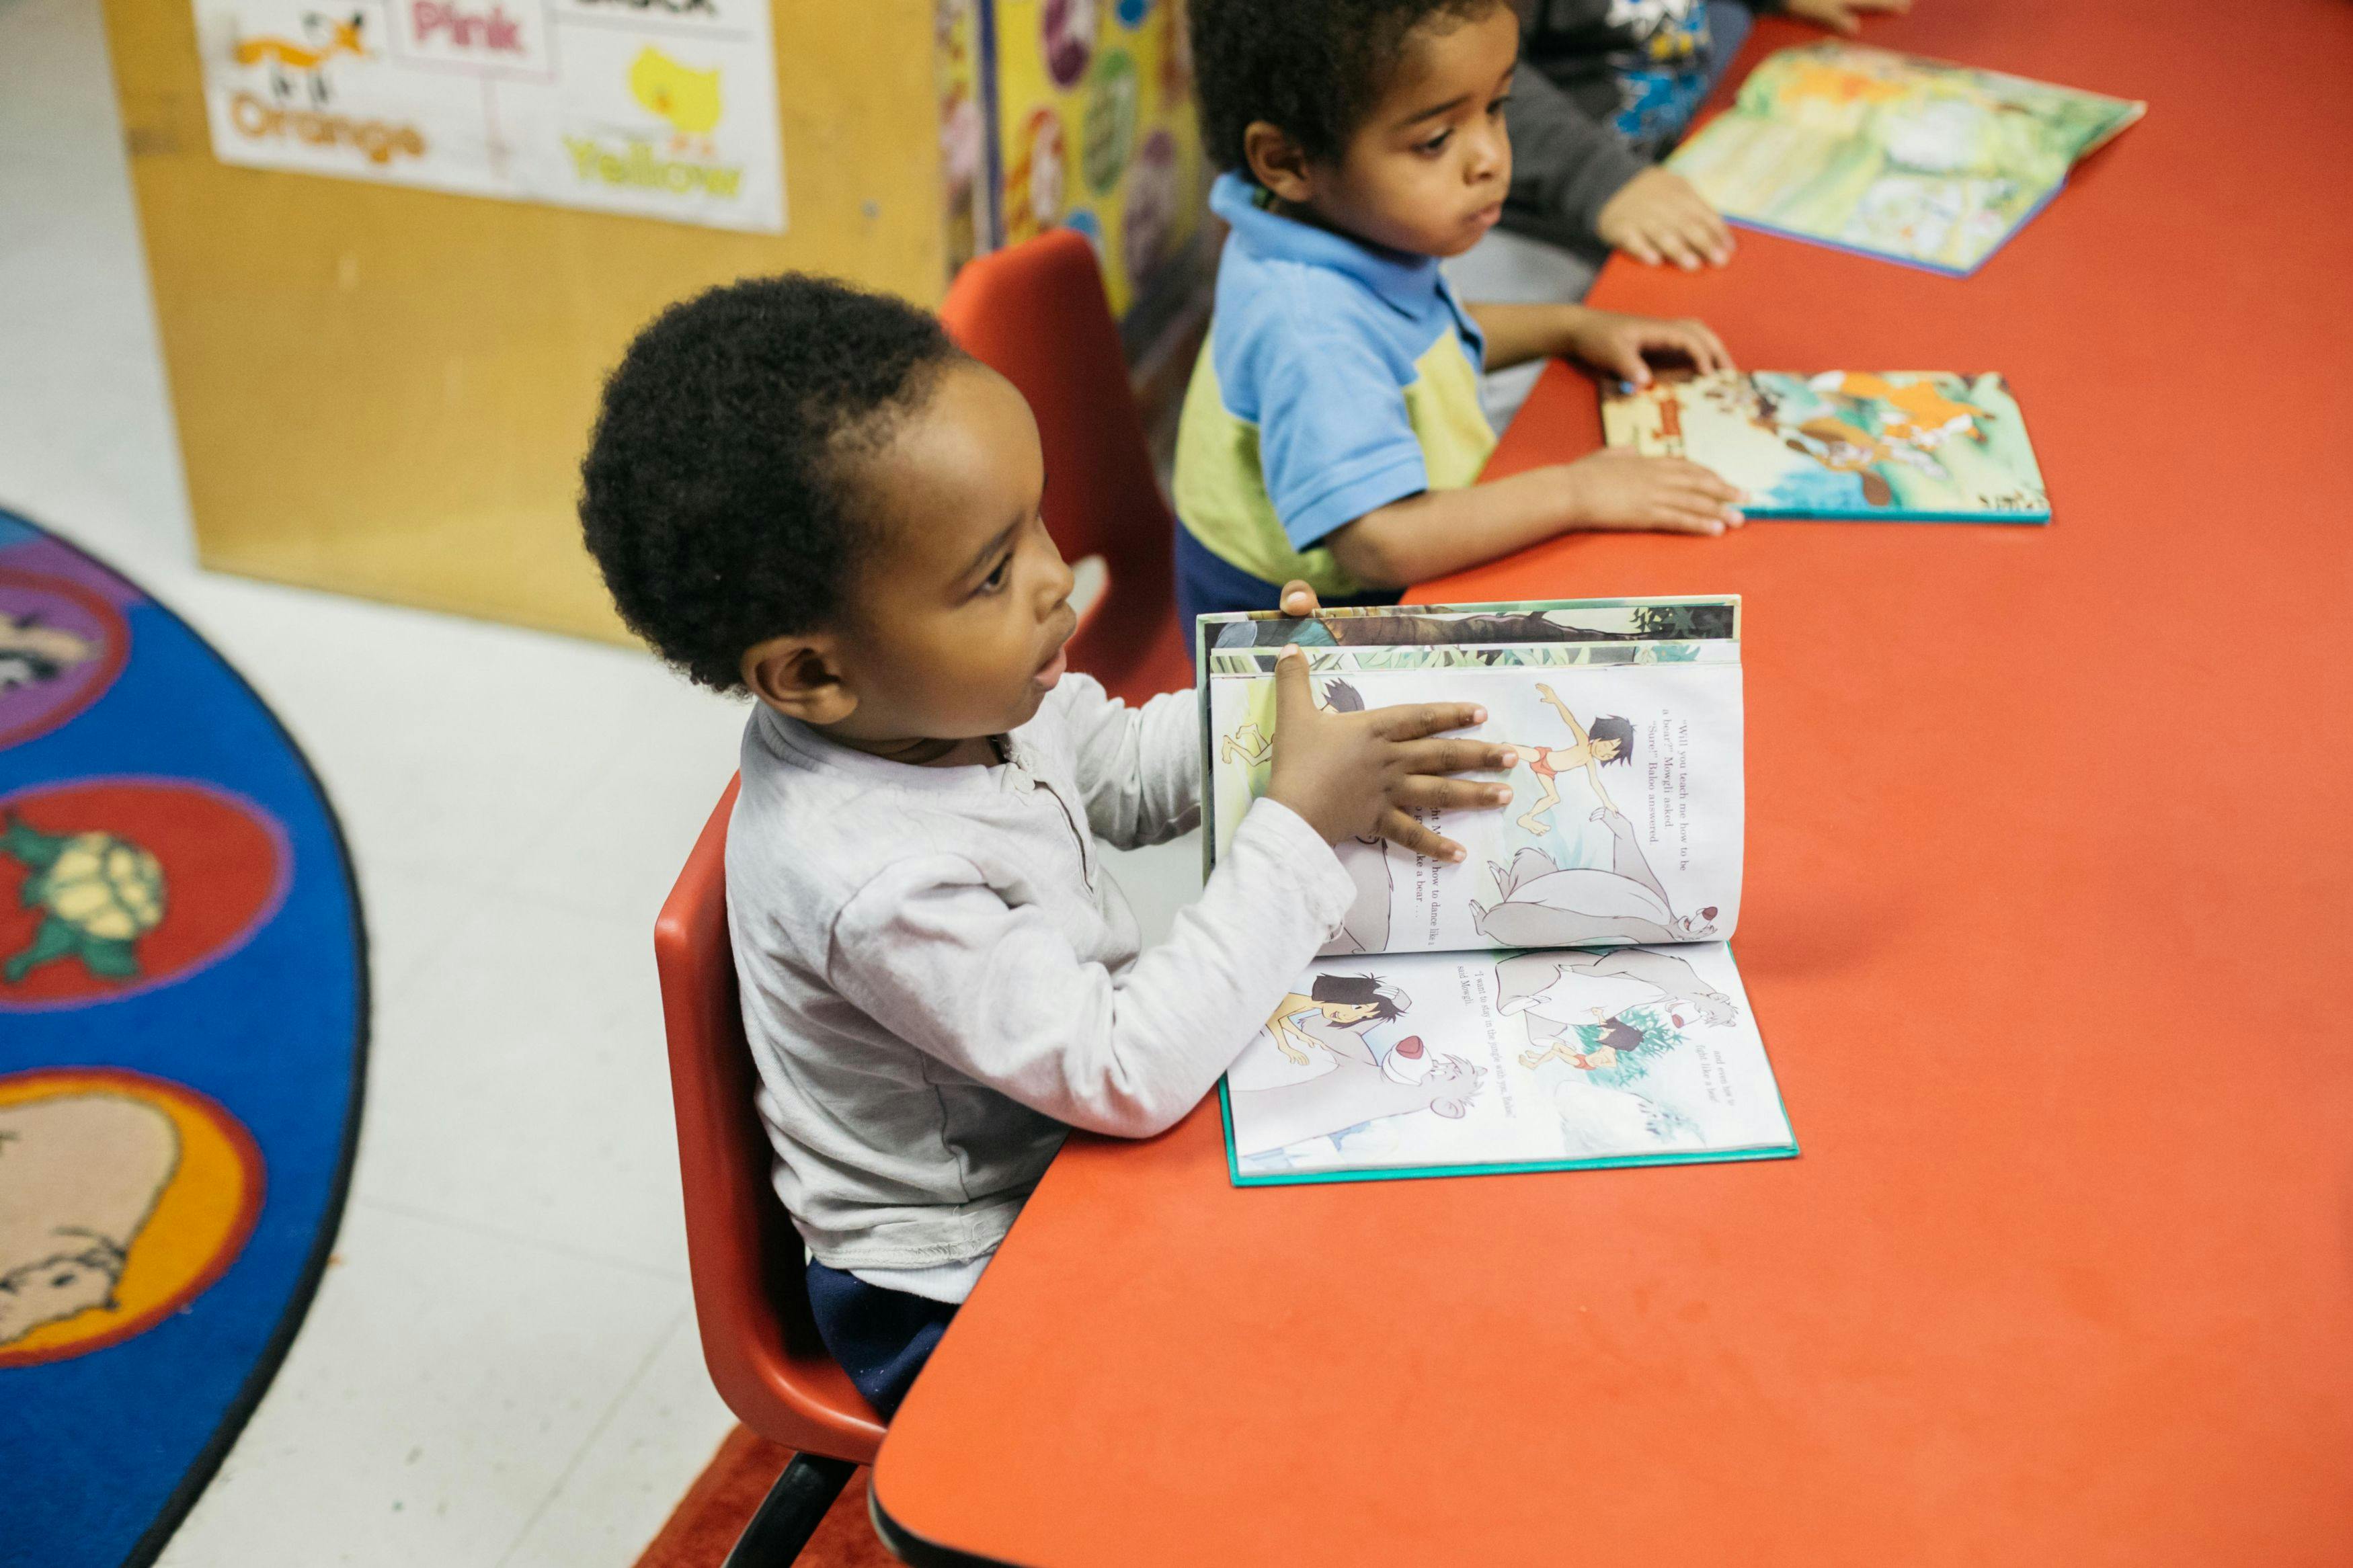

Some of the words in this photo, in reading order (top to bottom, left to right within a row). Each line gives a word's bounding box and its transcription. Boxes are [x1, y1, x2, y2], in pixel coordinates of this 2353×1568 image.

[412, 0, 529, 58] Pink
[230, 88, 427, 165] Orange
[561, 130, 746, 200] Yellow
[1678, 751, 1686, 768] you
[1648, 763, 1658, 790] Baloo
[1662, 757, 1673, 793] Mowgli
[1679, 773, 1689, 798] teach
[1649, 794, 1659, 845] answered.
[1664, 798, 1673, 829] asked.
[1680, 804, 1685, 819] me
[1680, 823, 1689, 843] how
[1681, 848, 1688, 856] to
[1680, 860, 1689, 871] be
[1432, 866, 1441, 886] how
[1416, 880, 1426, 902] bear
[1432, 890, 1439, 899] to
[1431, 902, 1441, 926] dance
[1429, 928, 1439, 941] like
[1458, 966, 1468, 979] said
[1476, 978, 1486, 995] want
[1481, 1005, 1490, 1018] stay
[1487, 1030, 1497, 1040] the
[1488, 1042, 1503, 1063] jungle
[1713, 1050, 1726, 1065] and
[1496, 1065, 1507, 1079] with
[1701, 1063, 1712, 1079] like
[1717, 1067, 1728, 1084] even
